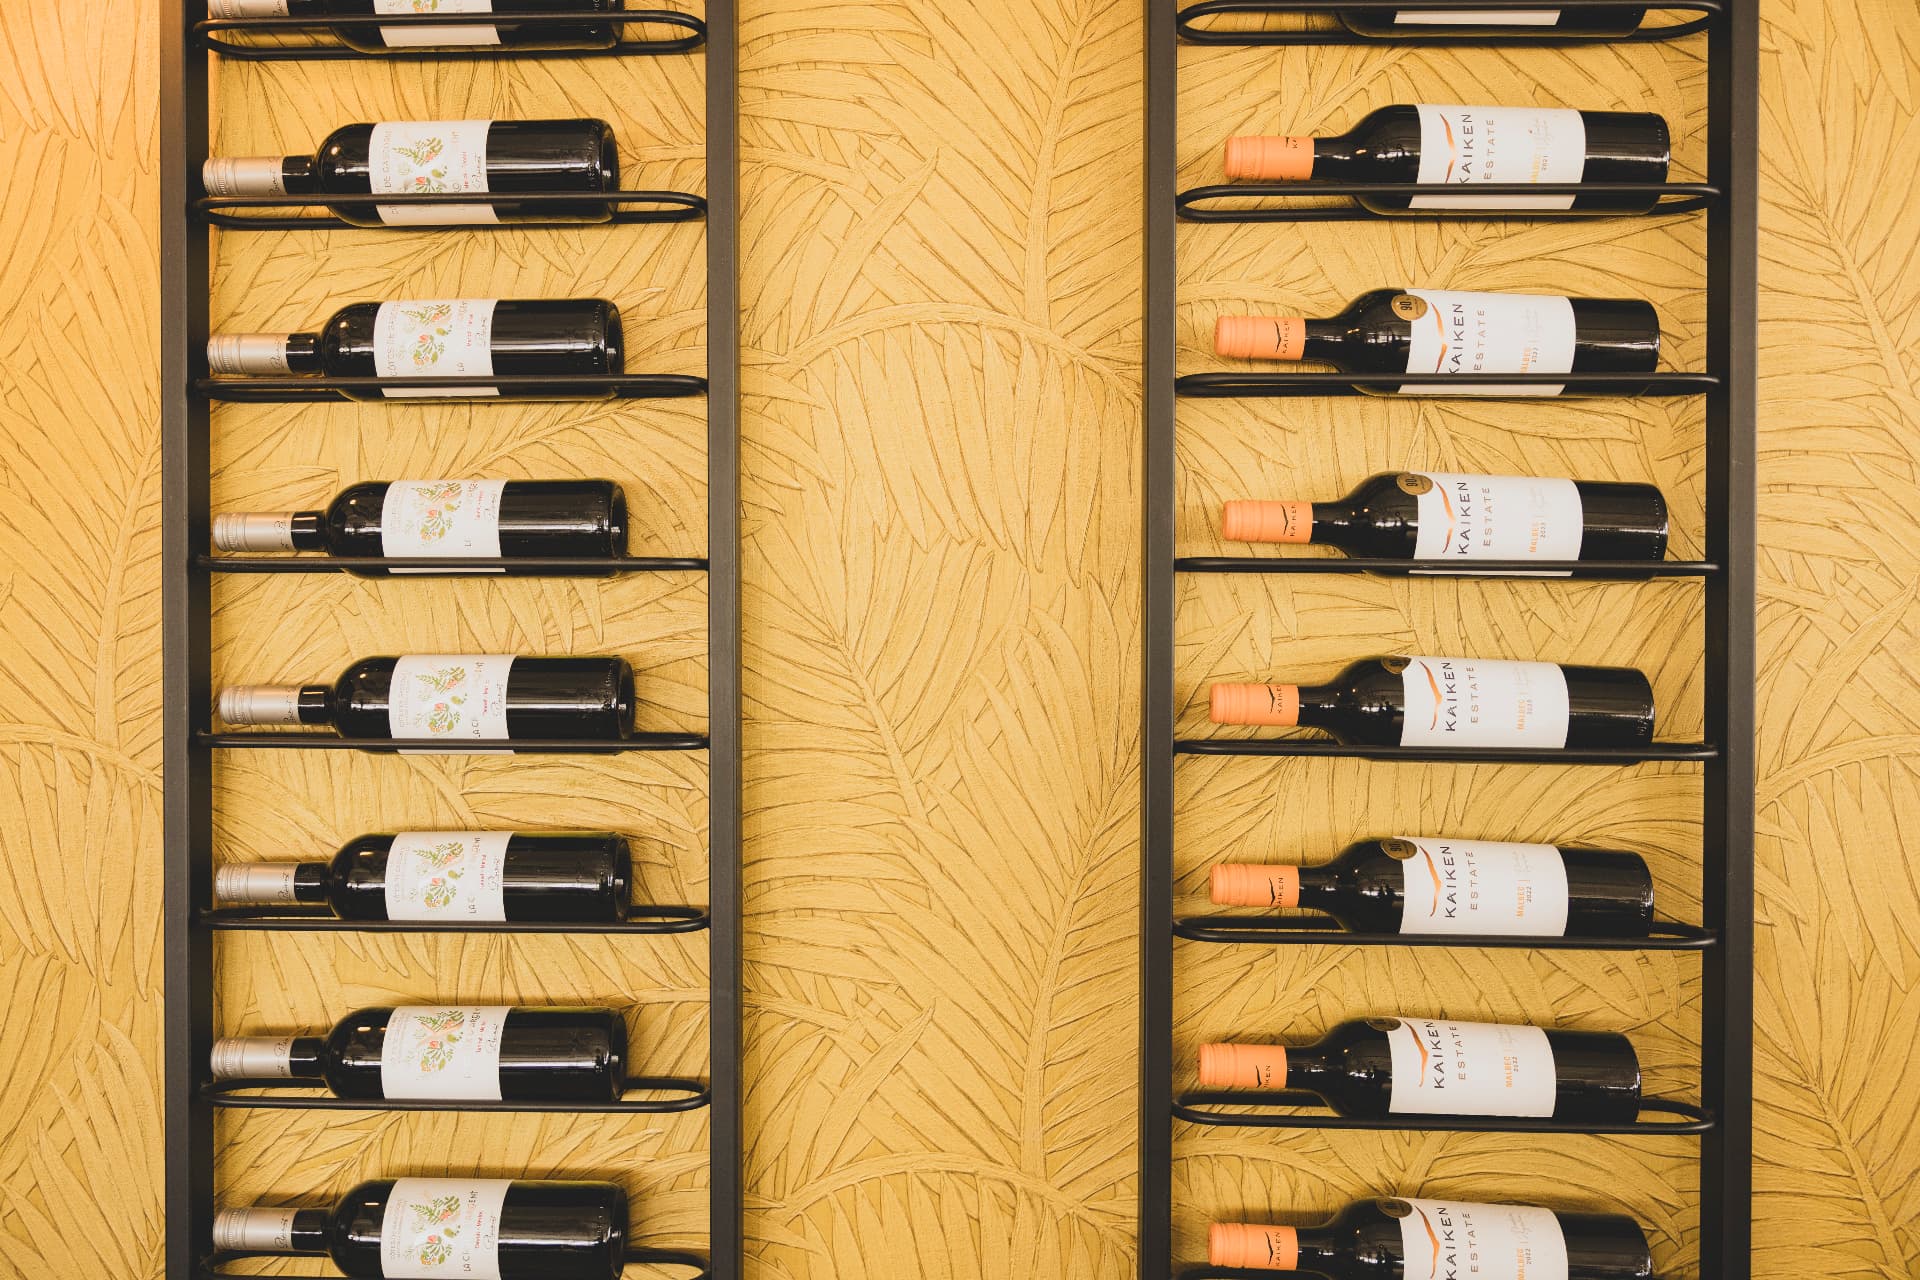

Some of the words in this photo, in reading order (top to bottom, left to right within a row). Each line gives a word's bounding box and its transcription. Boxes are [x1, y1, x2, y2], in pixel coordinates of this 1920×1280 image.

[1483, 119, 1494, 180] ESTATE
[1473, 310, 1485, 371] ESTATE
[1456, 482, 1472, 555] KAIKEN
[1480, 487, 1492, 547] ESTATE
[1441, 662, 1457, 732] KAIKEN
[1466, 666, 1479, 724] ESTATE
[1440, 845, 1457, 919] KAIKEN
[1465, 851, 1478, 910] ESTATE
[1516, 886, 1525, 919] MALBEC
[1424, 1021, 1445, 1089] KAIKEN
[1448, 1026, 1466, 1081] ESTATE
[1503, 1056, 1513, 1088] MALBEC
[1462, 1212, 1479, 1273] ESTATE
